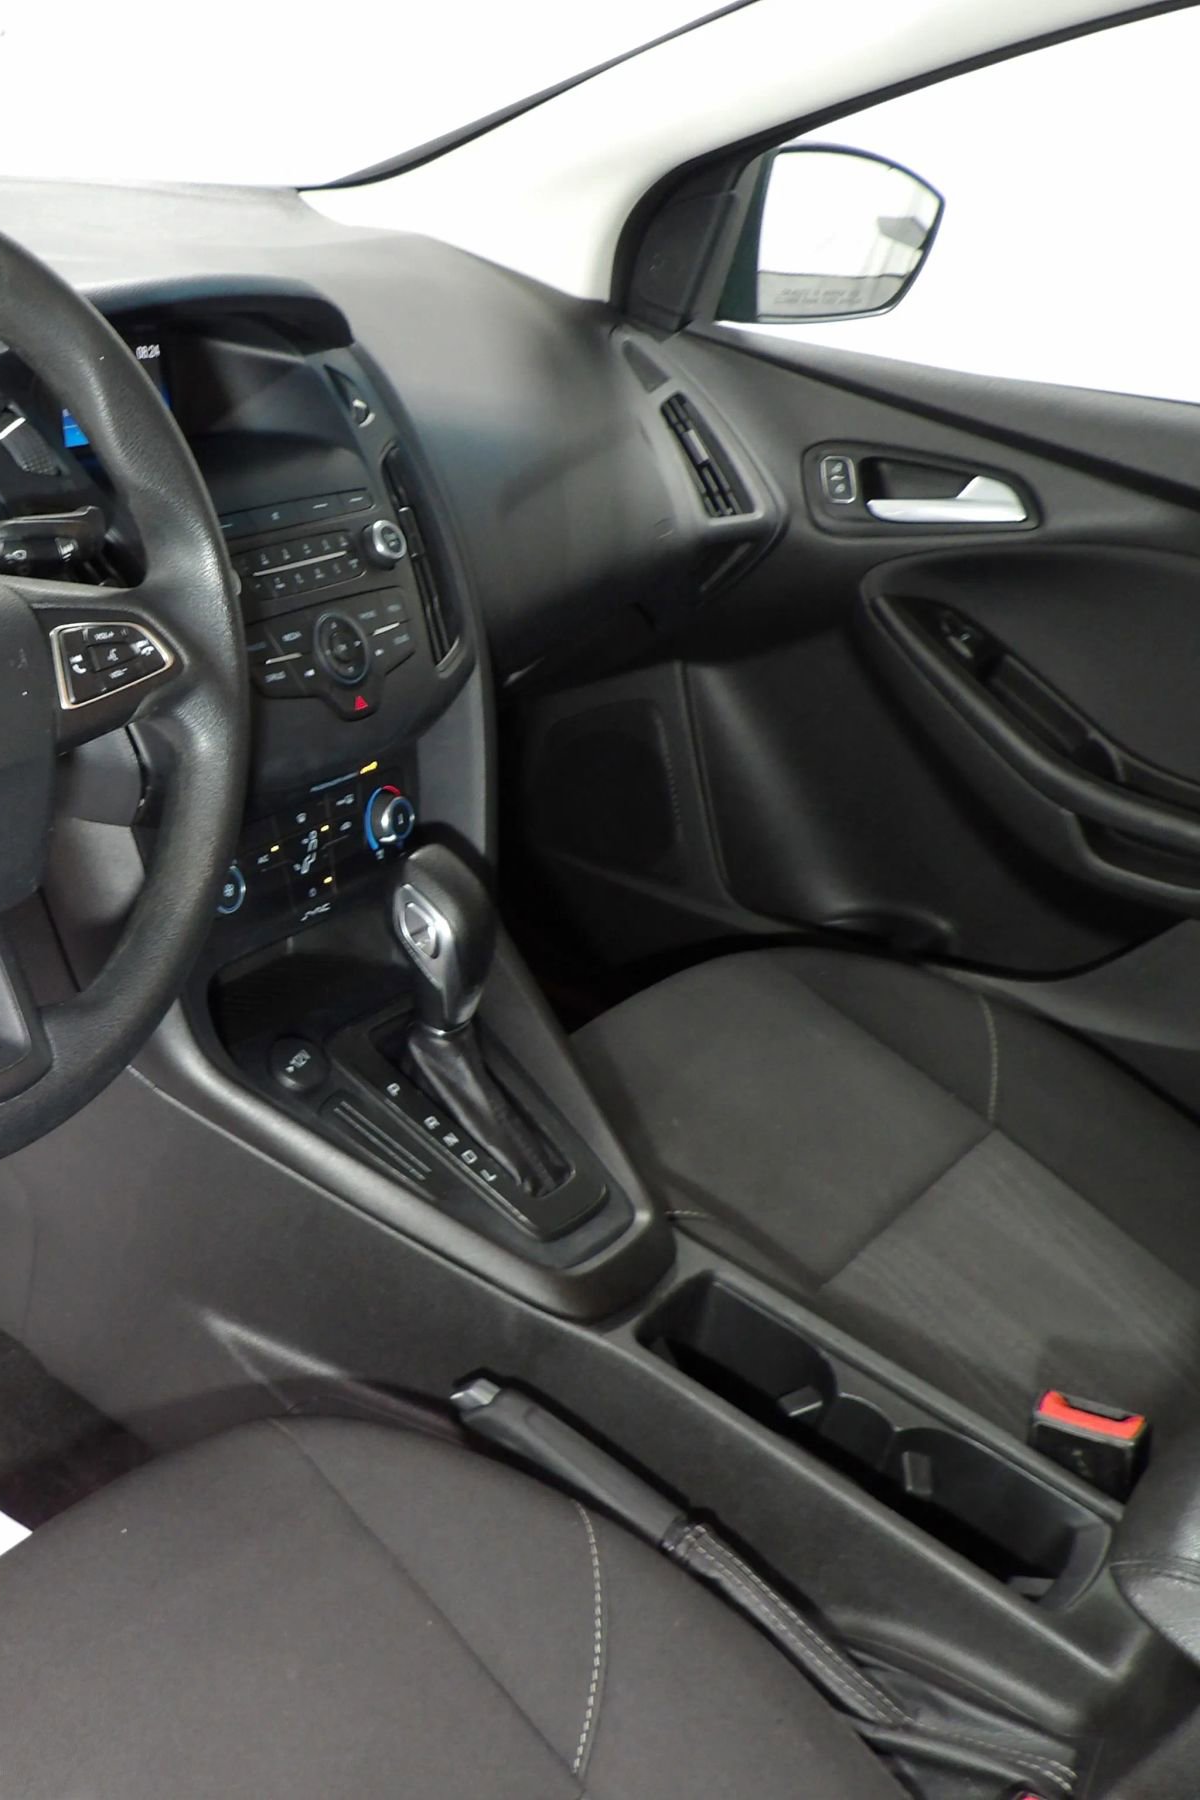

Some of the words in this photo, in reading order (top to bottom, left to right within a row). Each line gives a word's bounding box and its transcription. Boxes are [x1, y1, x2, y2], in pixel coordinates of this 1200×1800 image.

[386, 1082, 401, 1097] P
[423, 1115, 441, 1130] R
[442, 1132, 459, 1147] N
[461, 1149, 478, 1165] D
